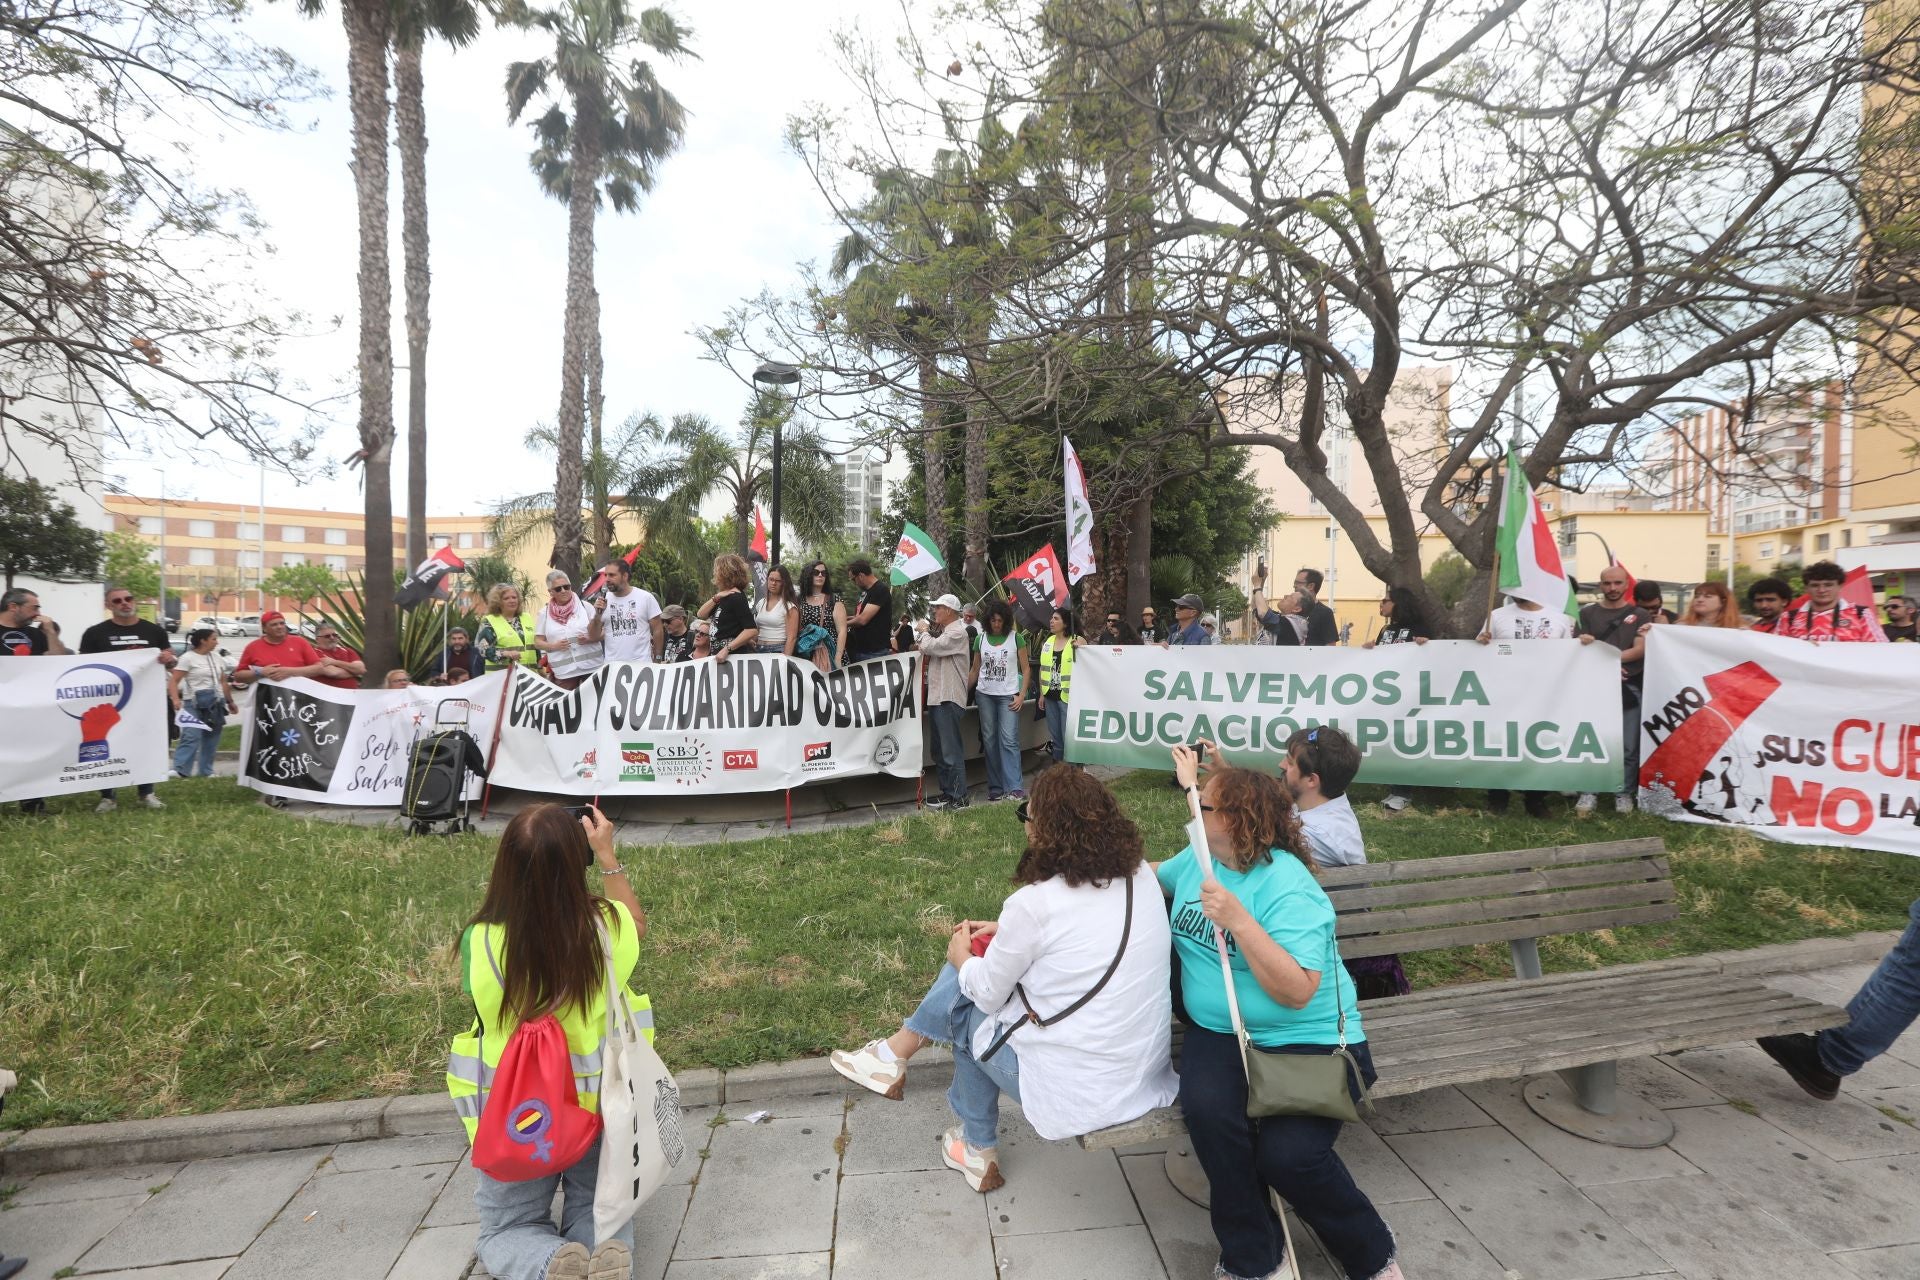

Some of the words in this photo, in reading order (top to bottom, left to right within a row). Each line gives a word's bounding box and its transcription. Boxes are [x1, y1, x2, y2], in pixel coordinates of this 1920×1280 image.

[56, 683, 121, 700] ACERINOX
[592, 663, 610, 731] Y
[610, 658, 804, 731] SOLIDARIDAD
[811, 657, 916, 728] OBRERA
[1143, 669, 1402, 706] SALVEMOS
[1419, 670, 1490, 706] LA
[256, 695, 339, 746] AMIGAS
[1642, 686, 1705, 747] MAYO
[361, 734, 400, 761] Solo
[1356, 708, 1606, 760] PÚBLICA
[63, 757, 127, 773] SINDICALISMO
[726, 754, 755, 767] CTA
[807, 746, 829, 758] CNT
[59, 775, 76, 783] SIN
[622, 764, 654, 775] USTEA
[1769, 775, 1874, 836] NO
